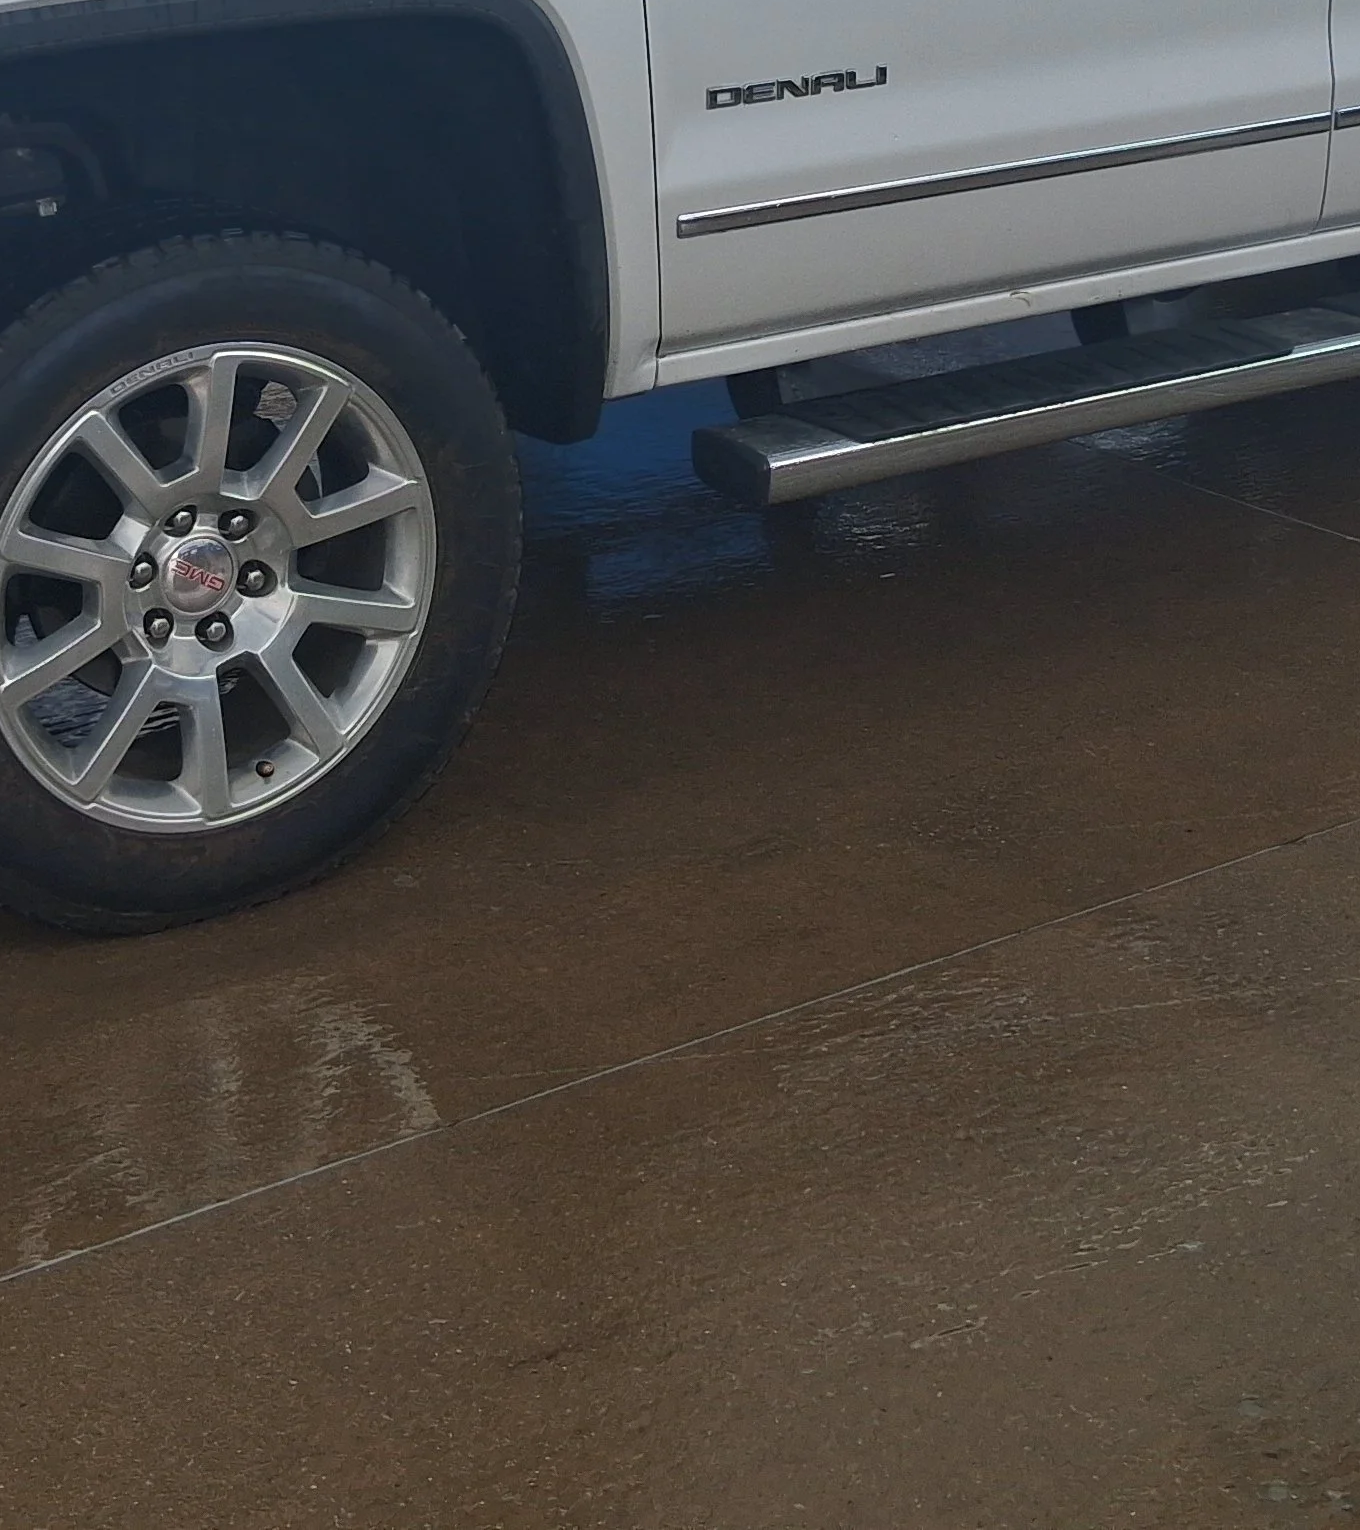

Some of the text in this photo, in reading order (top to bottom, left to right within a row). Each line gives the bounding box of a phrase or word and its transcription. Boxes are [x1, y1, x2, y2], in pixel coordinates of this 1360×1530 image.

[706, 63, 888, 110] DENALI
[110, 352, 194, 394] DENALI
[170, 558, 225, 592] GMC
